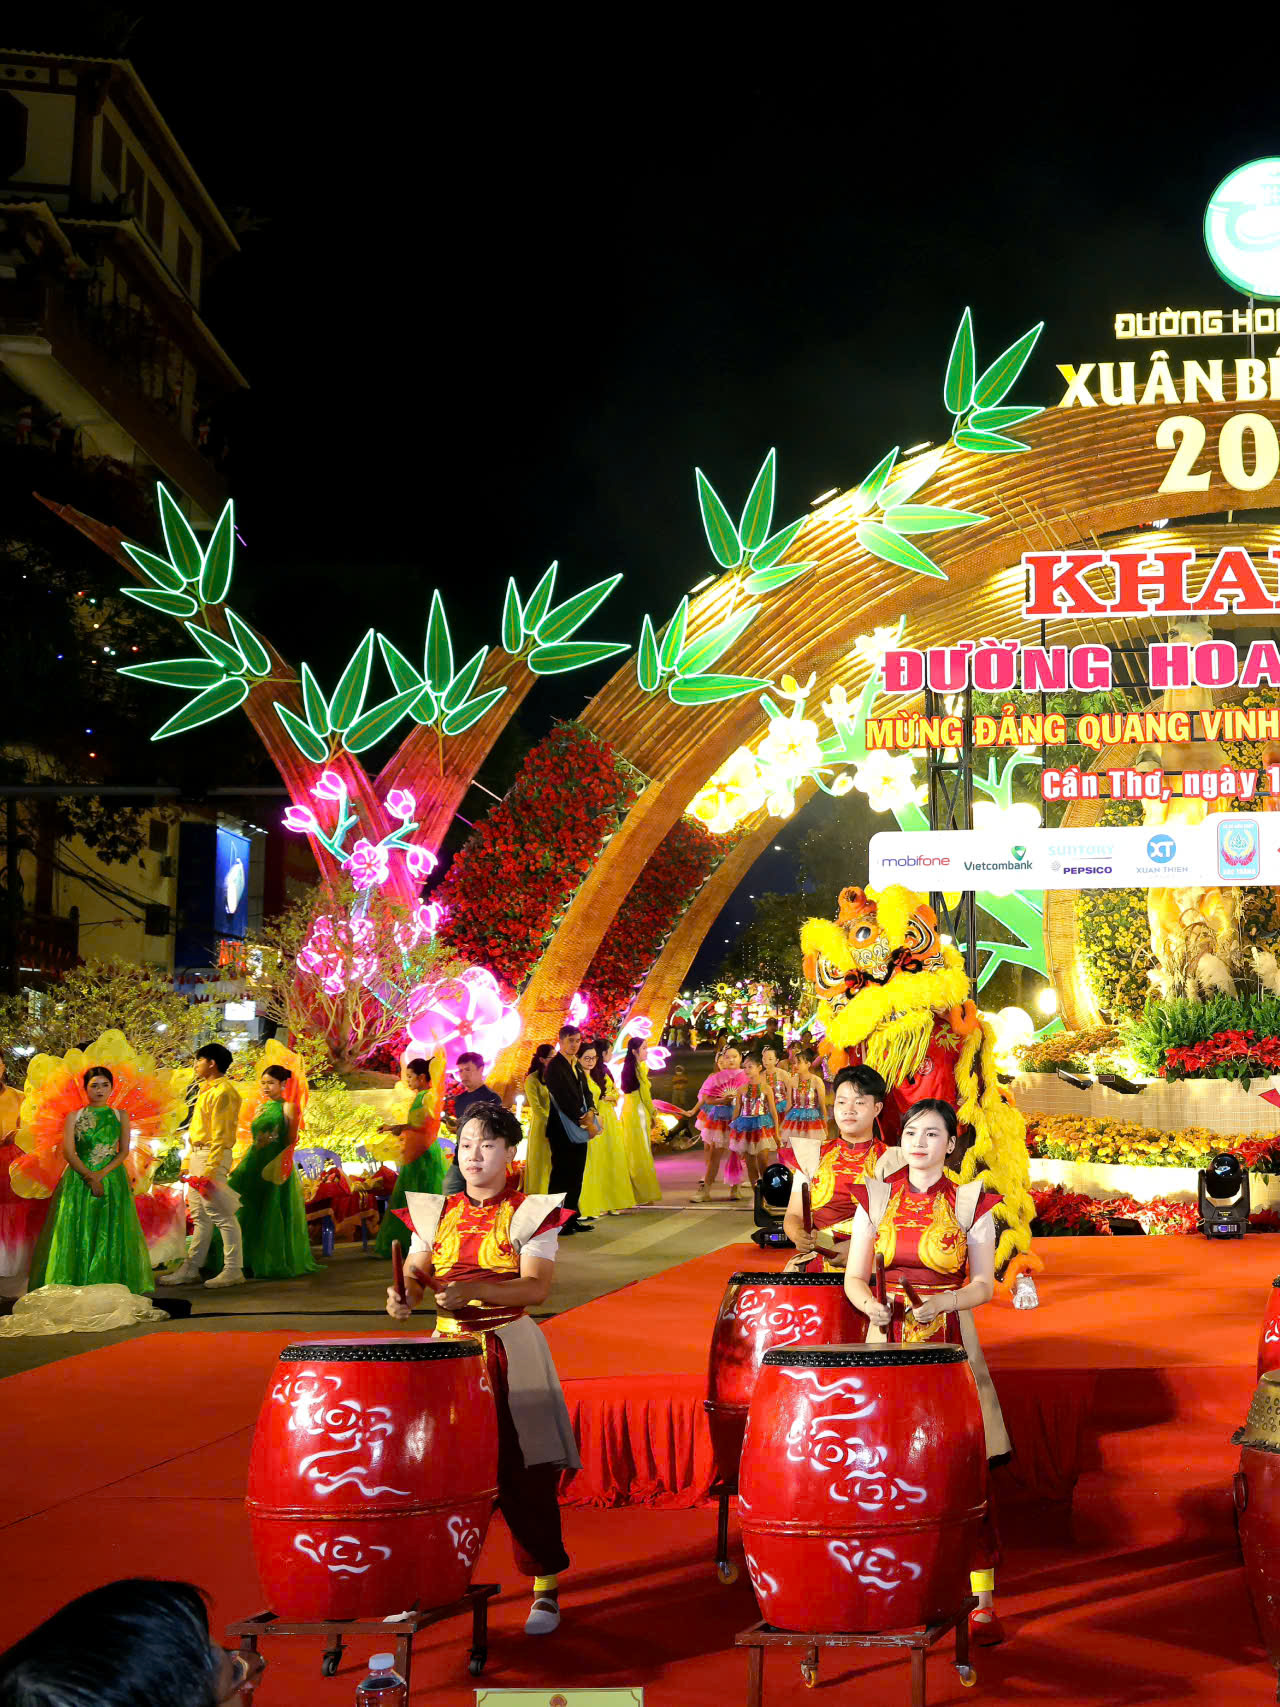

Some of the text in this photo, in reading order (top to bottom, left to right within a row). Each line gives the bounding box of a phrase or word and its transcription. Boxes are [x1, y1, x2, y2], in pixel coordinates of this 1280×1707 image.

[1115, 307, 1223, 337] ĐƯỜNG
[1056, 350, 1226, 408] XUÂN
[881, 637, 1113, 694] ĐƯỜNG
[865, 709, 963, 750] MỪNG
[973, 703, 1068, 747] ĐẢNG
[1077, 710, 1191, 750] QUANG
[1041, 765, 1100, 800] Cần
[1106, 768, 1174, 803] Thơ,
[1182, 764, 1258, 801] ngày
[882, 855, 950, 867] mobifone
[1150, 841, 1174, 858] XT
[963, 860, 1033, 871] Vietcombank
[1063, 866, 1113, 875] PEPSICO
